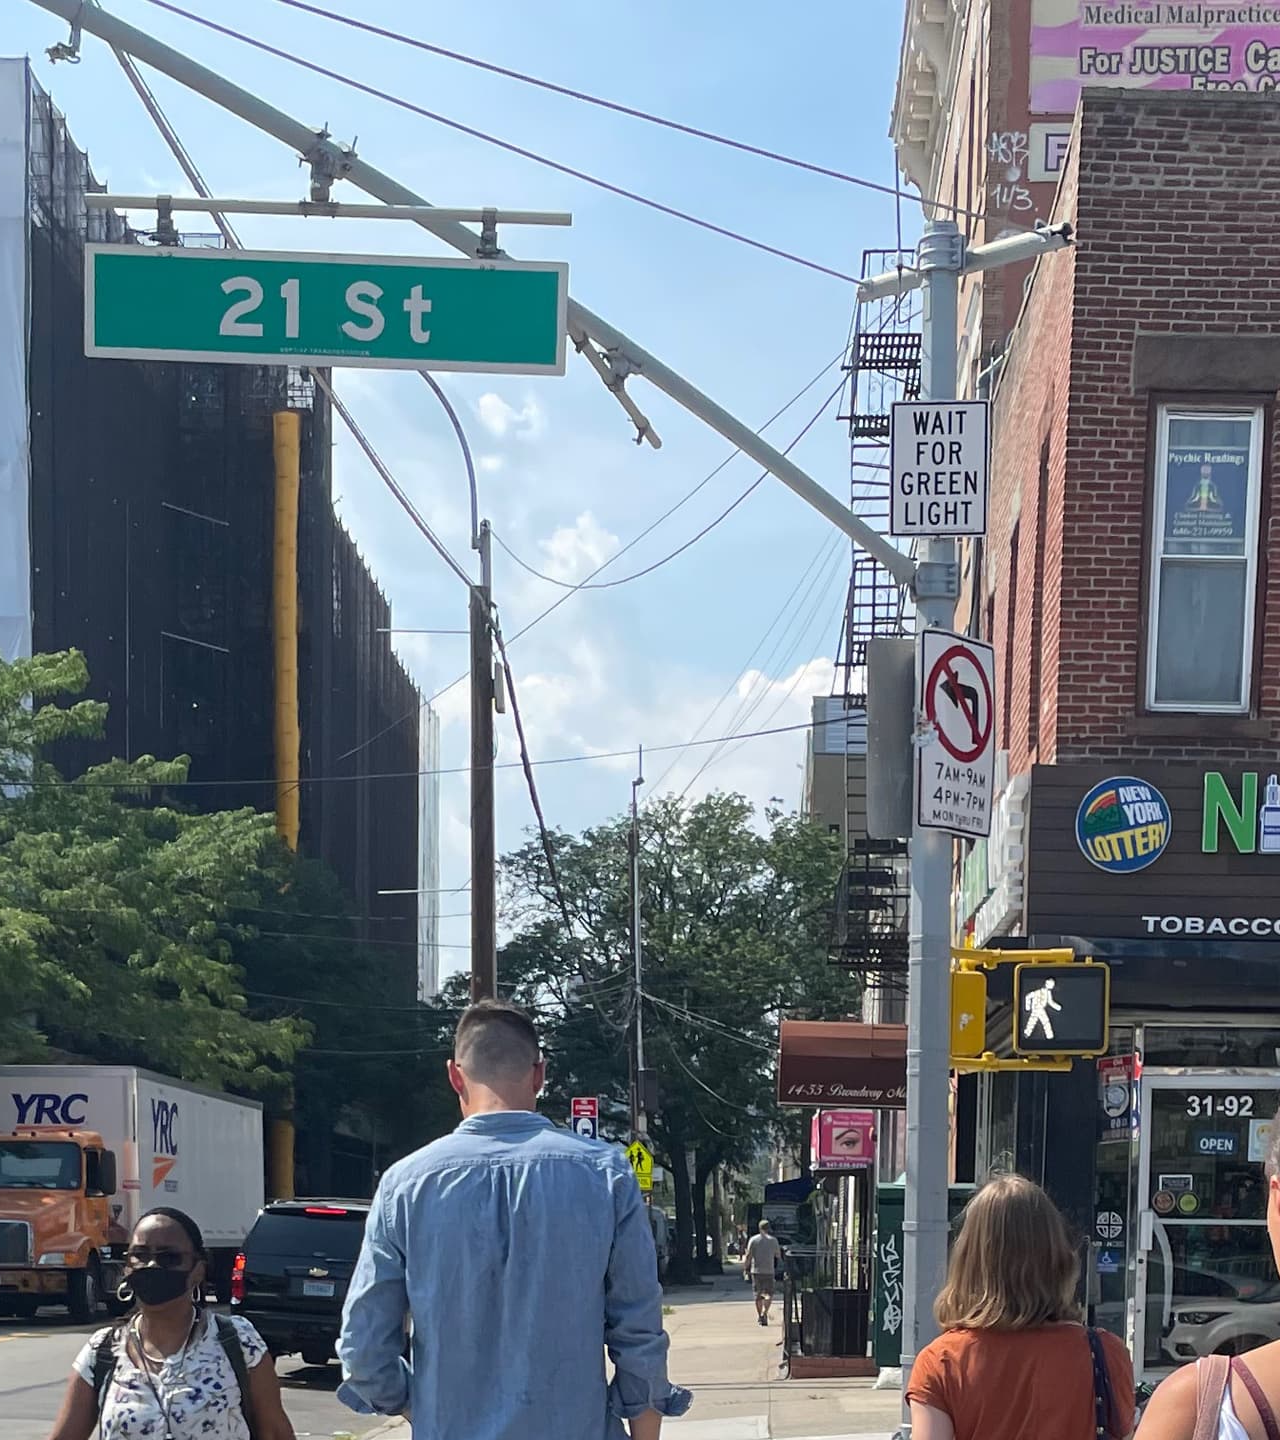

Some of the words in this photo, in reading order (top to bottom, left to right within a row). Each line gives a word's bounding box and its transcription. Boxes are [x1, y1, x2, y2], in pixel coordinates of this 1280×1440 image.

[1084, 4, 1160, 25] Medical
[1080, 47, 1122, 74] For
[1130, 47, 1230, 74] JUSTICE
[220, 276, 300, 338] 21
[341, 280, 432, 344] St
[913, 411, 967, 436] WAIT
[916, 441, 962, 466] FOR
[900, 470, 978, 496] GREEN
[905, 501, 972, 526] LIGHT
[935, 762, 986, 788] 7AM-9AM
[933, 786, 985, 812] 4PM-7PM
[1119, 785, 1152, 802] NEW
[933, 809, 954, 822] MON
[1123, 801, 1164, 826] YORK
[1086, 821, 1167, 863] LOTTERY
[826, 1082, 884, 1101] Broadway
[11, 1093, 89, 1125] YRC
[1186, 1095, 1254, 1117] 31-92
[151, 1097, 179, 1156] YRC
[1199, 1137, 1234, 1151] OPEN
